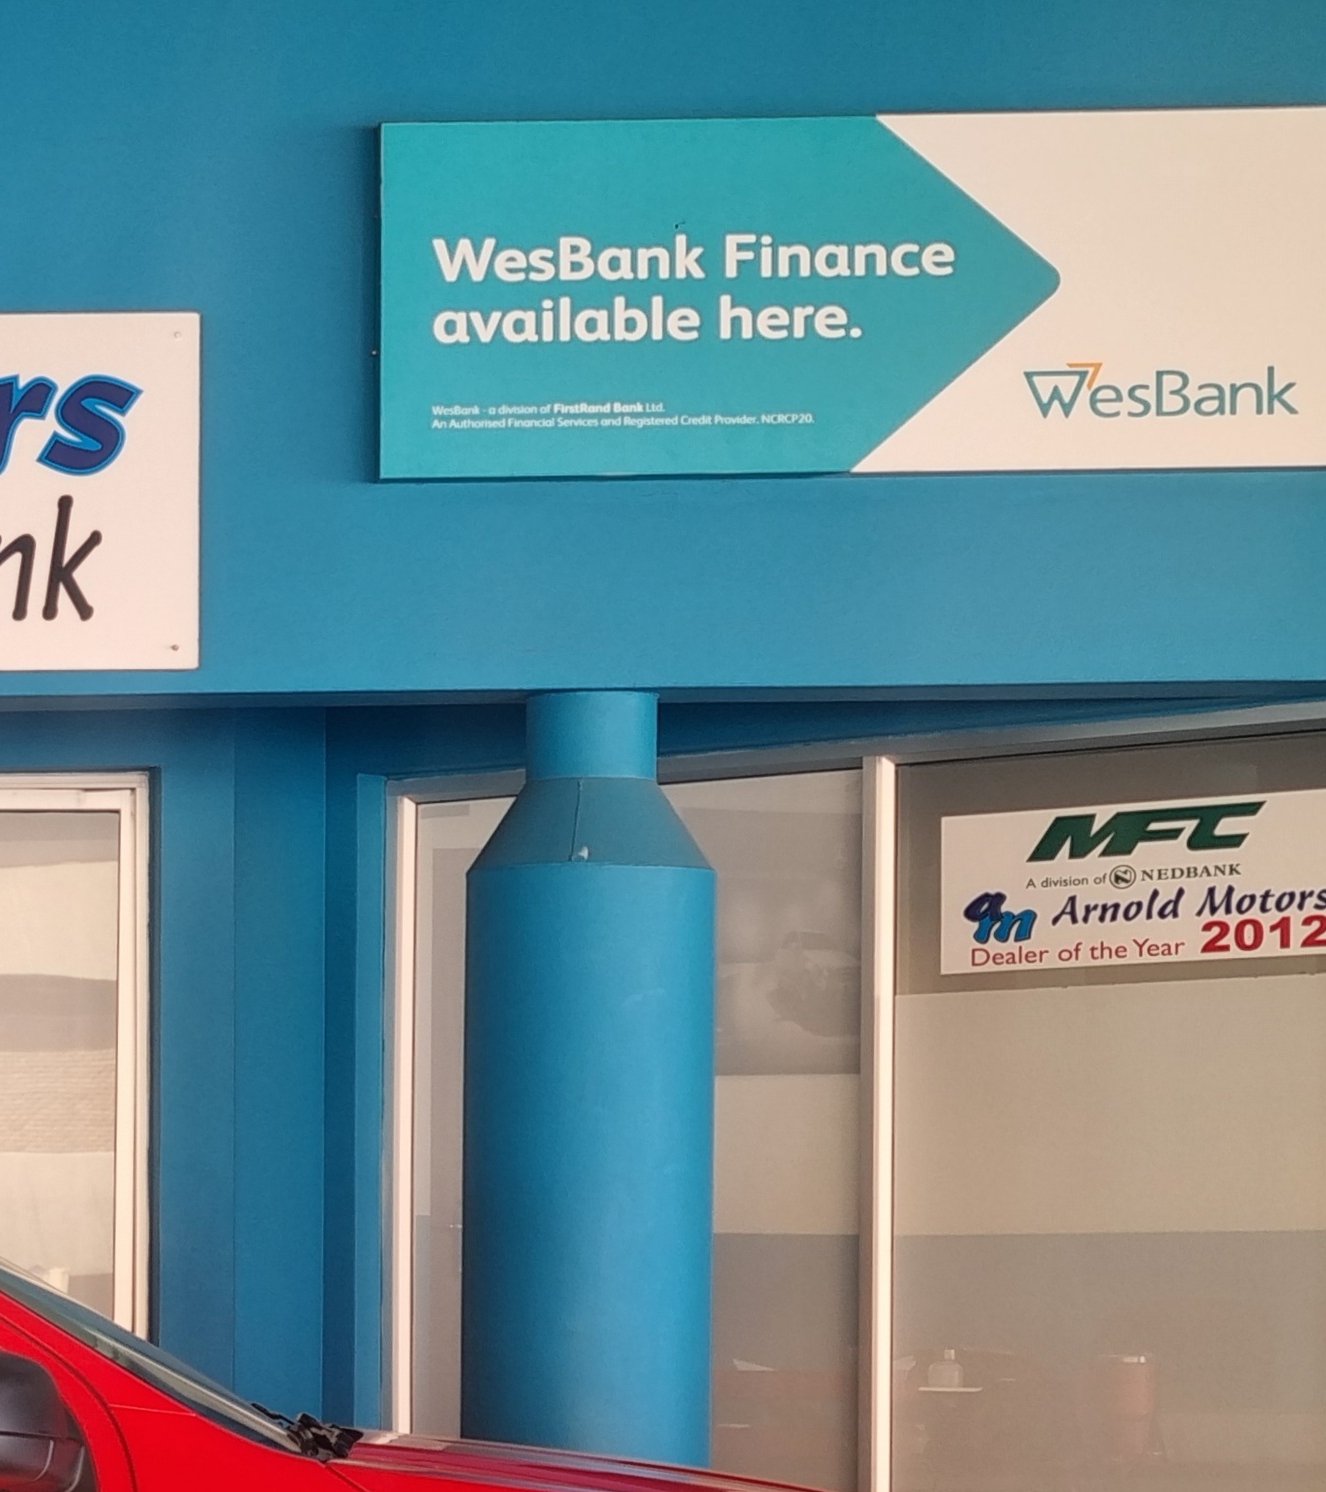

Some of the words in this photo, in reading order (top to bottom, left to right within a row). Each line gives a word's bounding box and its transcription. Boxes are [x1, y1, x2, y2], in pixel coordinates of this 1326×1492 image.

[433, 235, 706, 282] WesBank
[725, 234, 956, 279] Finance
[433, 295, 700, 344] available
[719, 294, 863, 340] here.
[432, 405, 480, 416] WesBank
[488, 407, 496, 415] a
[498, 404, 538, 415] division
[540, 403, 551, 414] of
[553, 402, 611, 414] FirstRand
[613, 402, 644, 413] Bank
[646, 402, 666, 413] Ltd.
[1023, 362, 1299, 418] WesBank
[432, 418, 447, 429] An
[449, 417, 506, 429] Authorised
[508, 417, 555, 428] Financial
[557, 416, 598, 427] Services
[600, 416, 622, 427] and
[623, 415, 679, 428] Registered
[680, 415, 713, 426] Credit
[1026, 801, 1267, 862] MFC
[1025, 878, 1037, 889] A
[1041, 874, 1089, 888] division
[1093, 872, 1107, 886] of
[1140, 863, 1242, 882] NEDBANK
[1051, 886, 1186, 927] Arnold
[1195, 884, 1326, 917] Motors
[971, 945, 1049, 967] Dealer
[1057, 941, 1082, 963] of
[1090, 940, 1128, 961] the
[1132, 938, 1187, 959] Year
[1200, 914, 1326, 954] 2012
